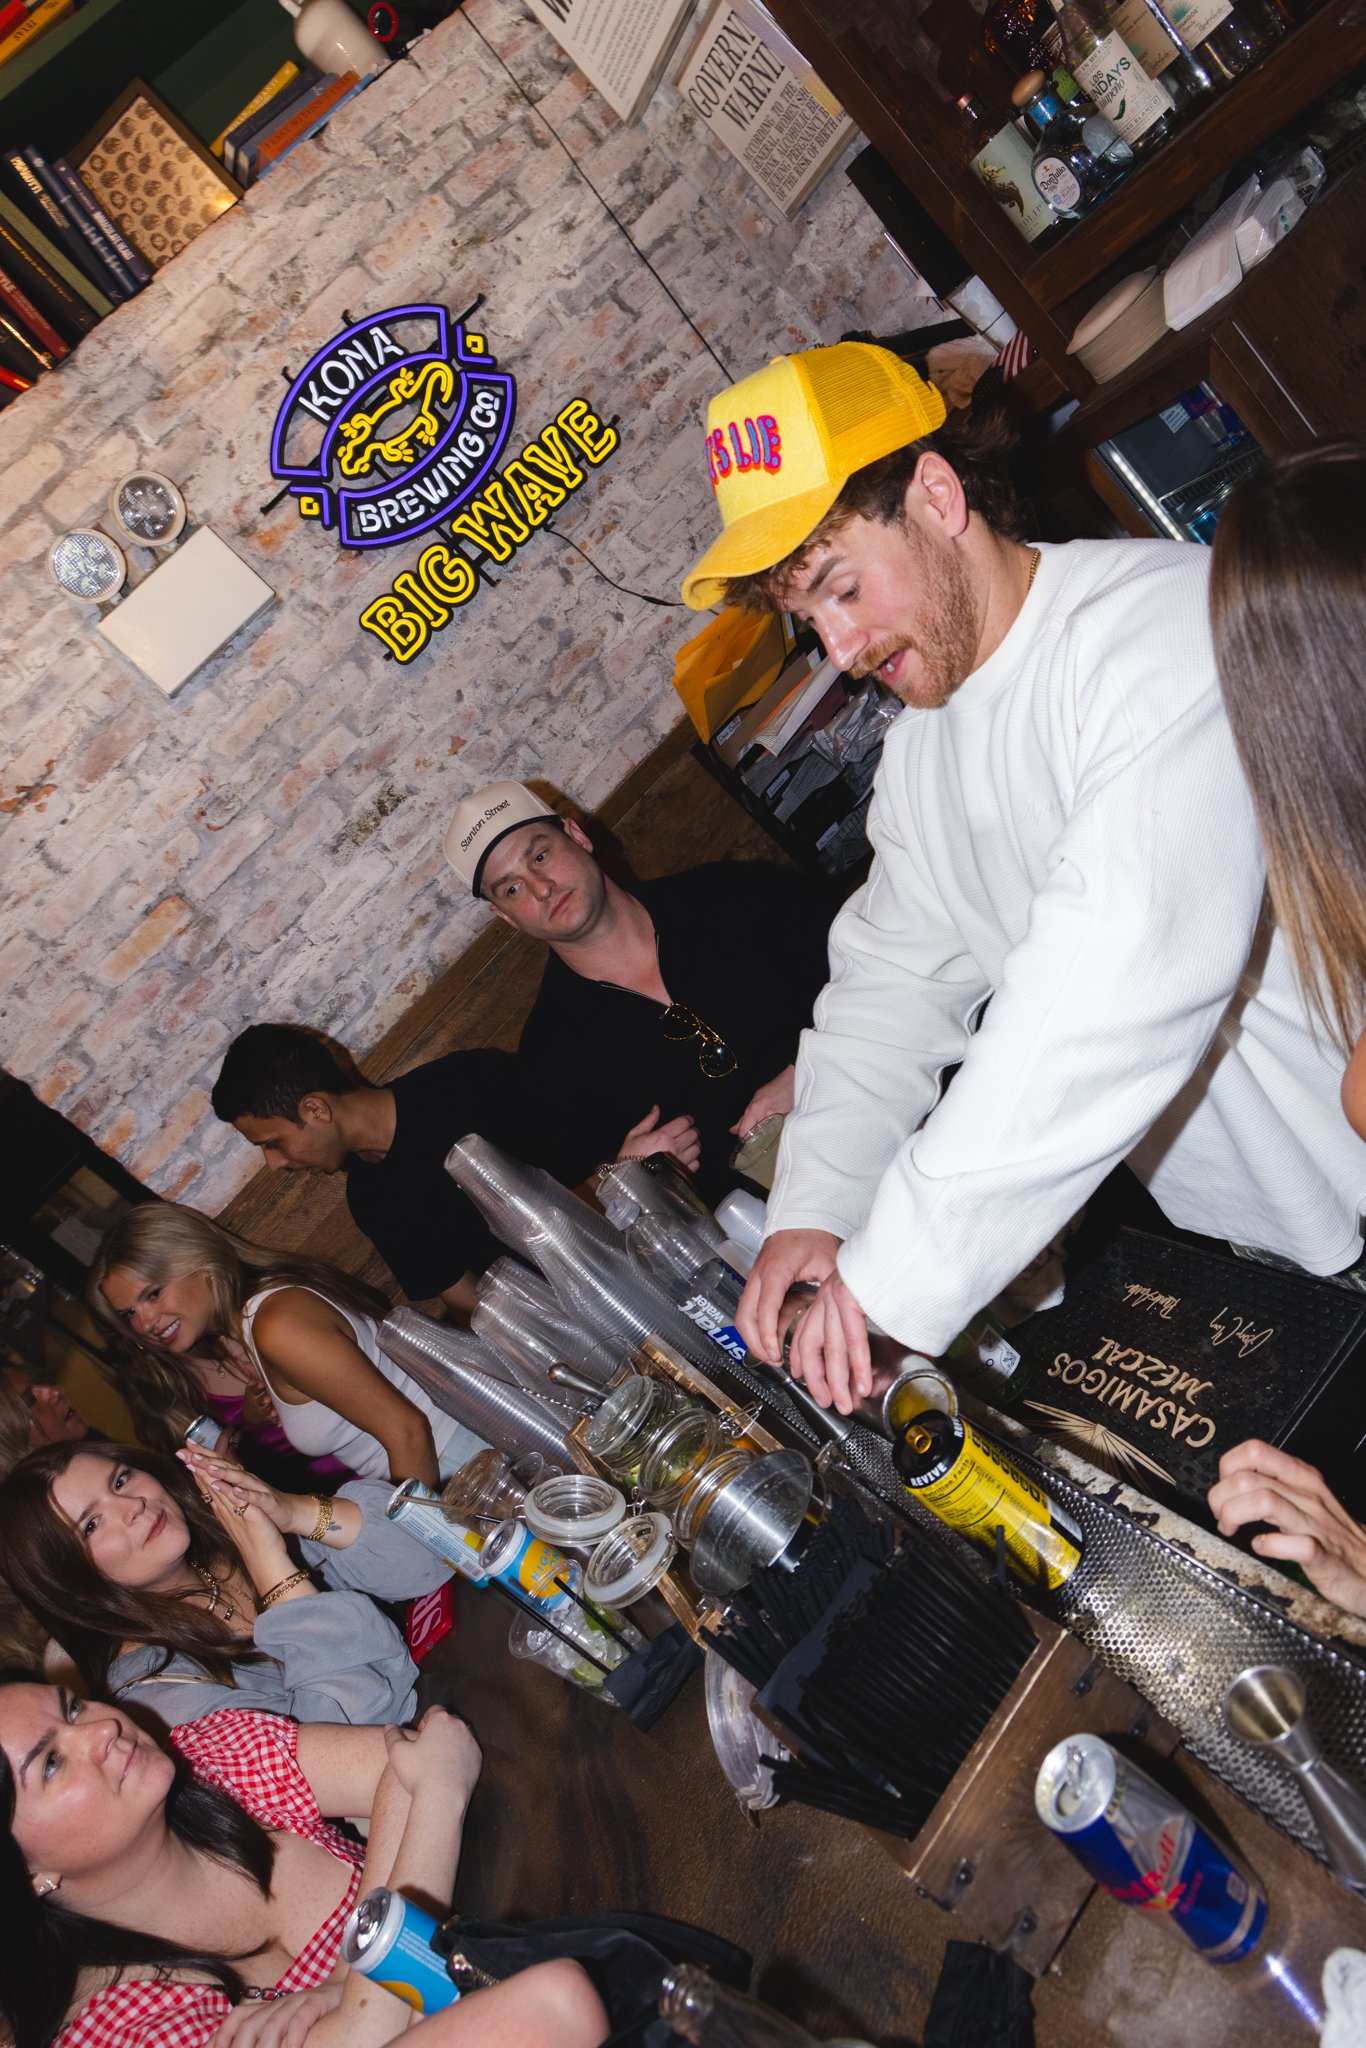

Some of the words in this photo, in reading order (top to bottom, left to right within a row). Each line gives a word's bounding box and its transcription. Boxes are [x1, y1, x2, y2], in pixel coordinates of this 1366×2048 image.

[688, 10, 756, 119] GOVERN
[721, 41, 786, 132] WARNI
[1088, 37, 1114, 63] MEXICO
[743, 113, 776, 164] ACCORDING
[770, 100, 785, 119] TO
[779, 80, 798, 104] THE
[758, 152, 780, 184] DRINK
[778, 110, 813, 161] ALCOHOLIC
[803, 96, 820, 116] BE
[774, 99, 801, 135] WOMEN
[1133, 97, 1159, 125] BLANCO
[766, 159, 791, 193] DURING
[786, 114, 826, 167] PREGNANCY
[775, 186, 788, 201] OF
[784, 168, 802, 192] THE
[796, 152, 813, 180] RISK
[806, 143, 820, 160] OF
[815, 116, 839, 152] BIRTH
[298, 326, 405, 421] KONA
[358, 431, 481, 534] BREWING
[359, 543, 477, 665] BIG
[451, 398, 623, 565] WAVE
[461, 818, 486, 852] Stanton
[484, 799, 510, 820] Street
[676, 1299, 746, 1361] smart
[691, 1294, 725, 1321] water
[1047, 1352, 1216, 1448] CASAMIGOS
[1091, 1336, 1216, 1405] MEZCAL
[910, 1462, 947, 1487] REVIVE
[922, 1479, 954, 1498] Nutrition
[1141, 1832, 1176, 1894] Bull
